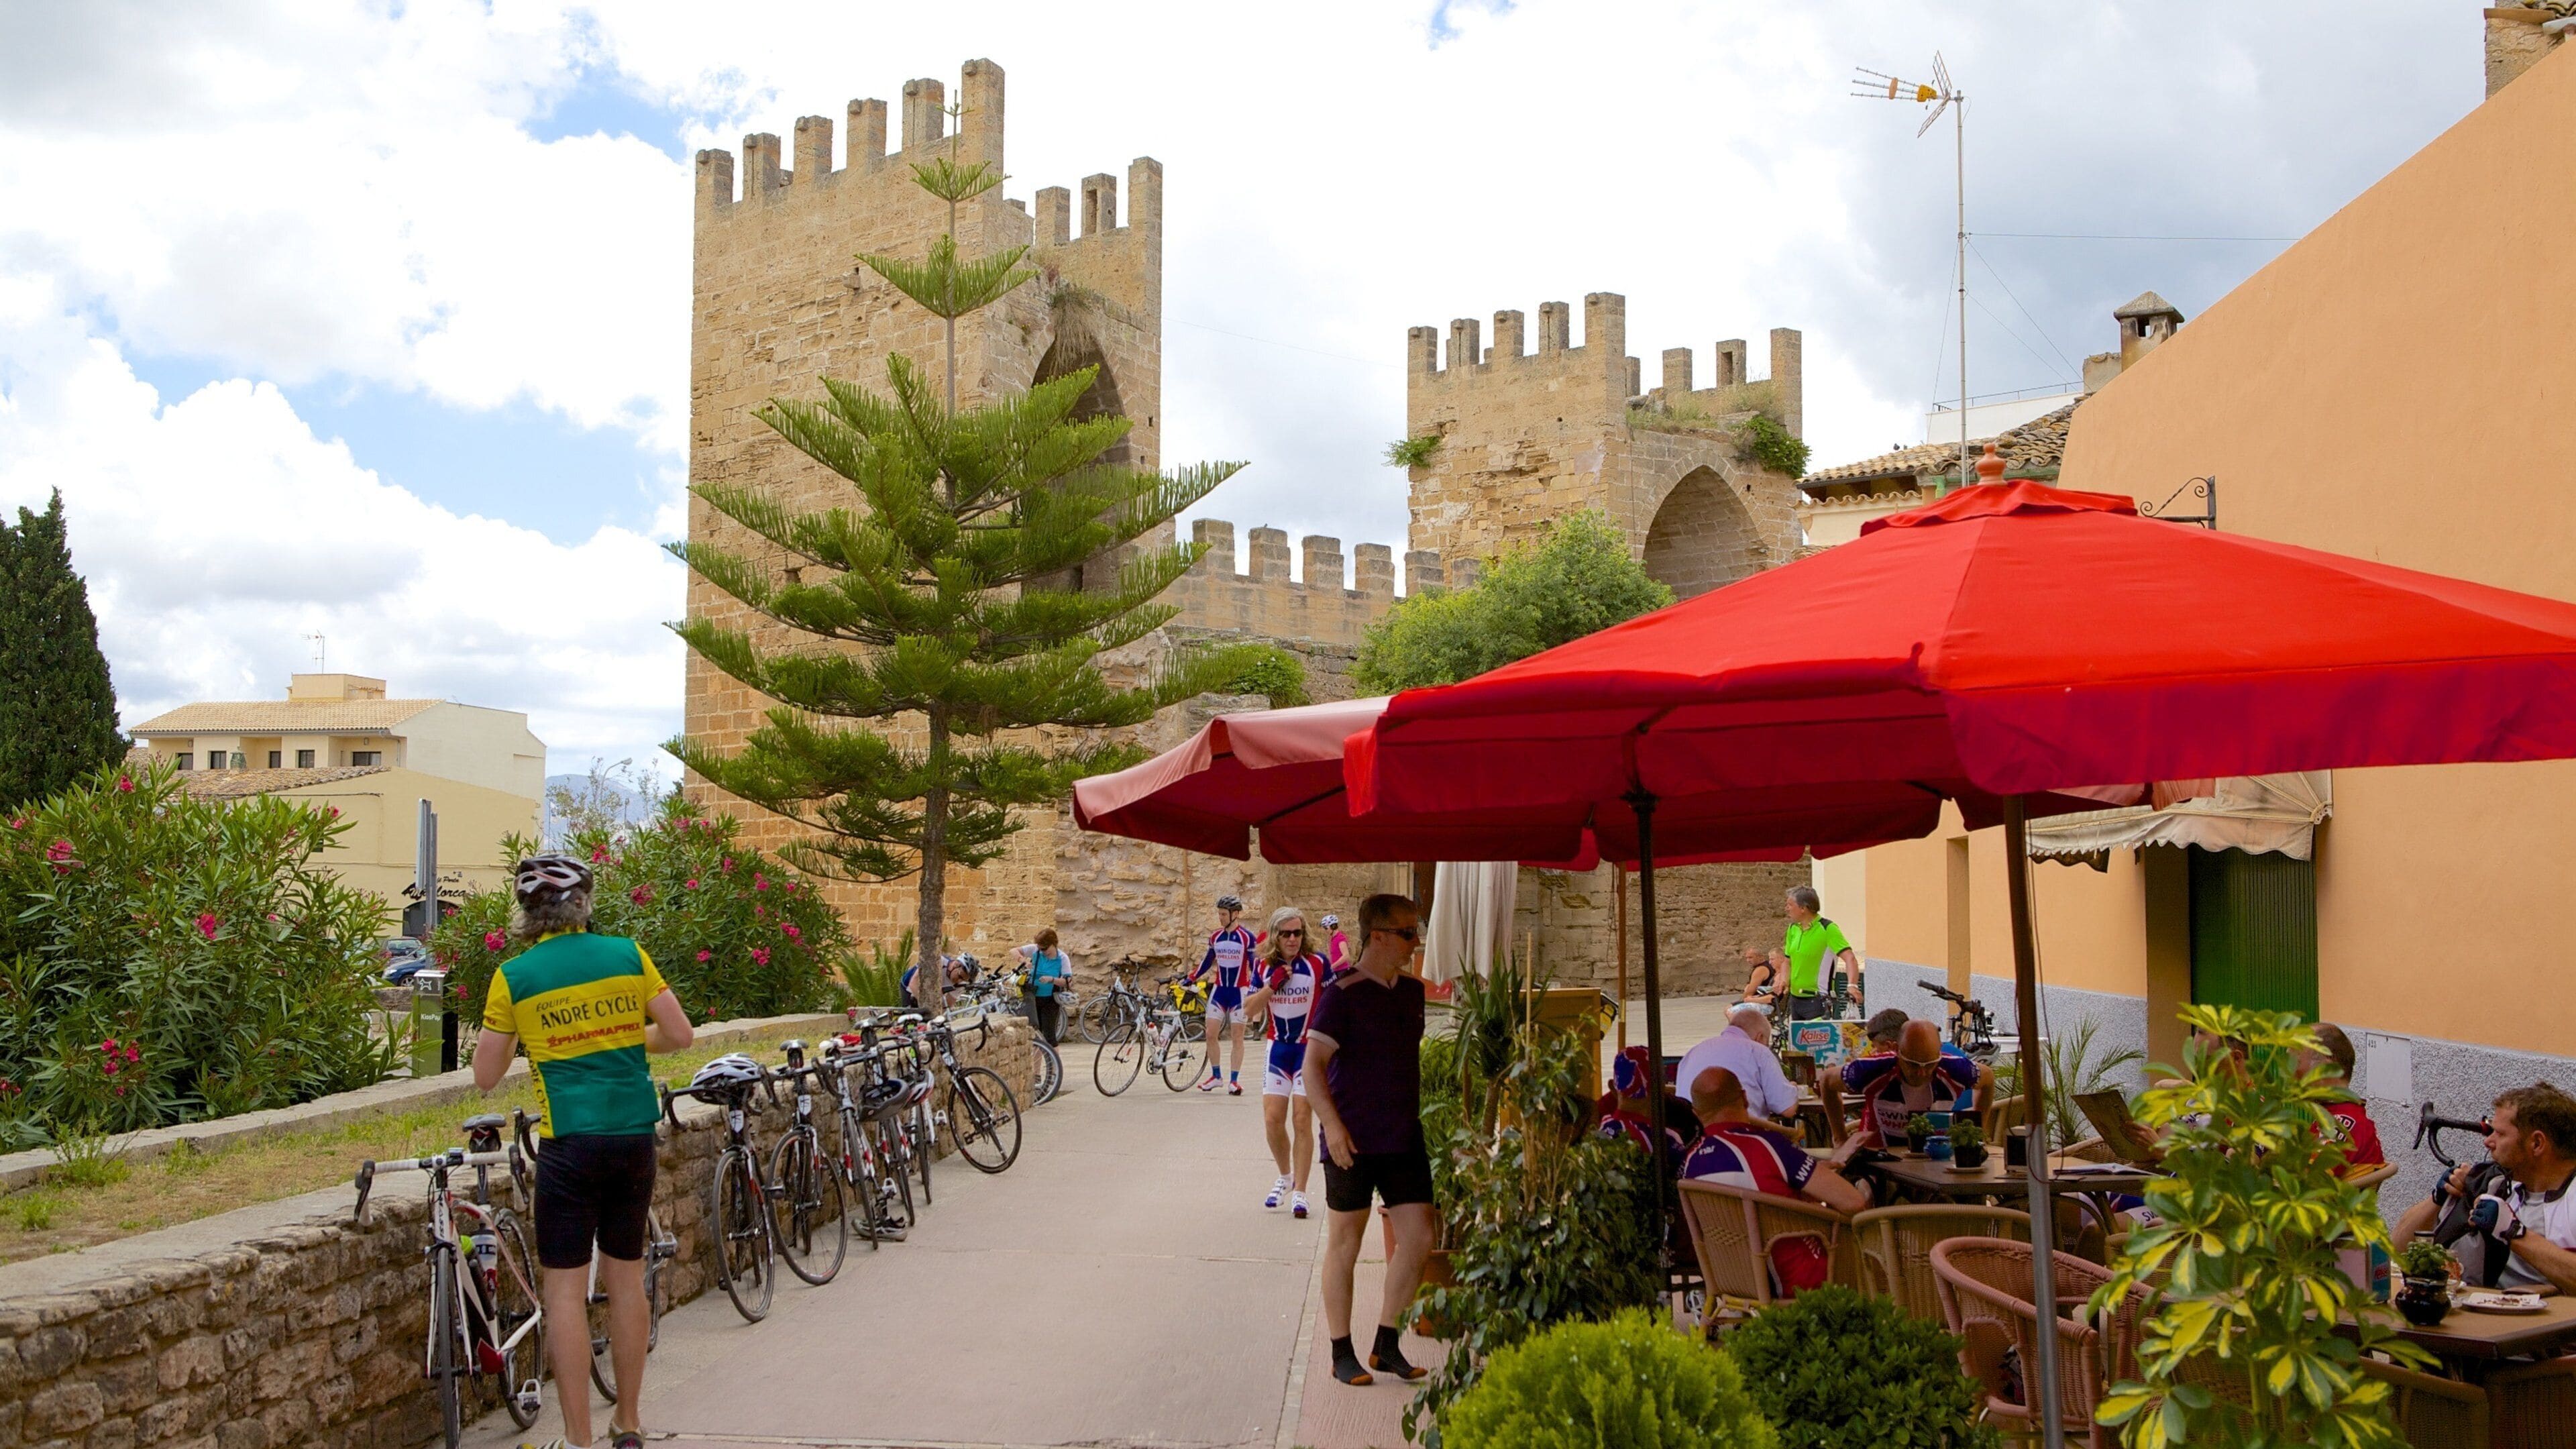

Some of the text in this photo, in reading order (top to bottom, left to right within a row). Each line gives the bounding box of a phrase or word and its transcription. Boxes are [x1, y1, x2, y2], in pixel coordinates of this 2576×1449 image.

[421, 1014, 441, 1022] KiosPay
[541, 1001, 591, 1030] ANDRÉ
[1800, 1028, 1829, 1044] Kalise
